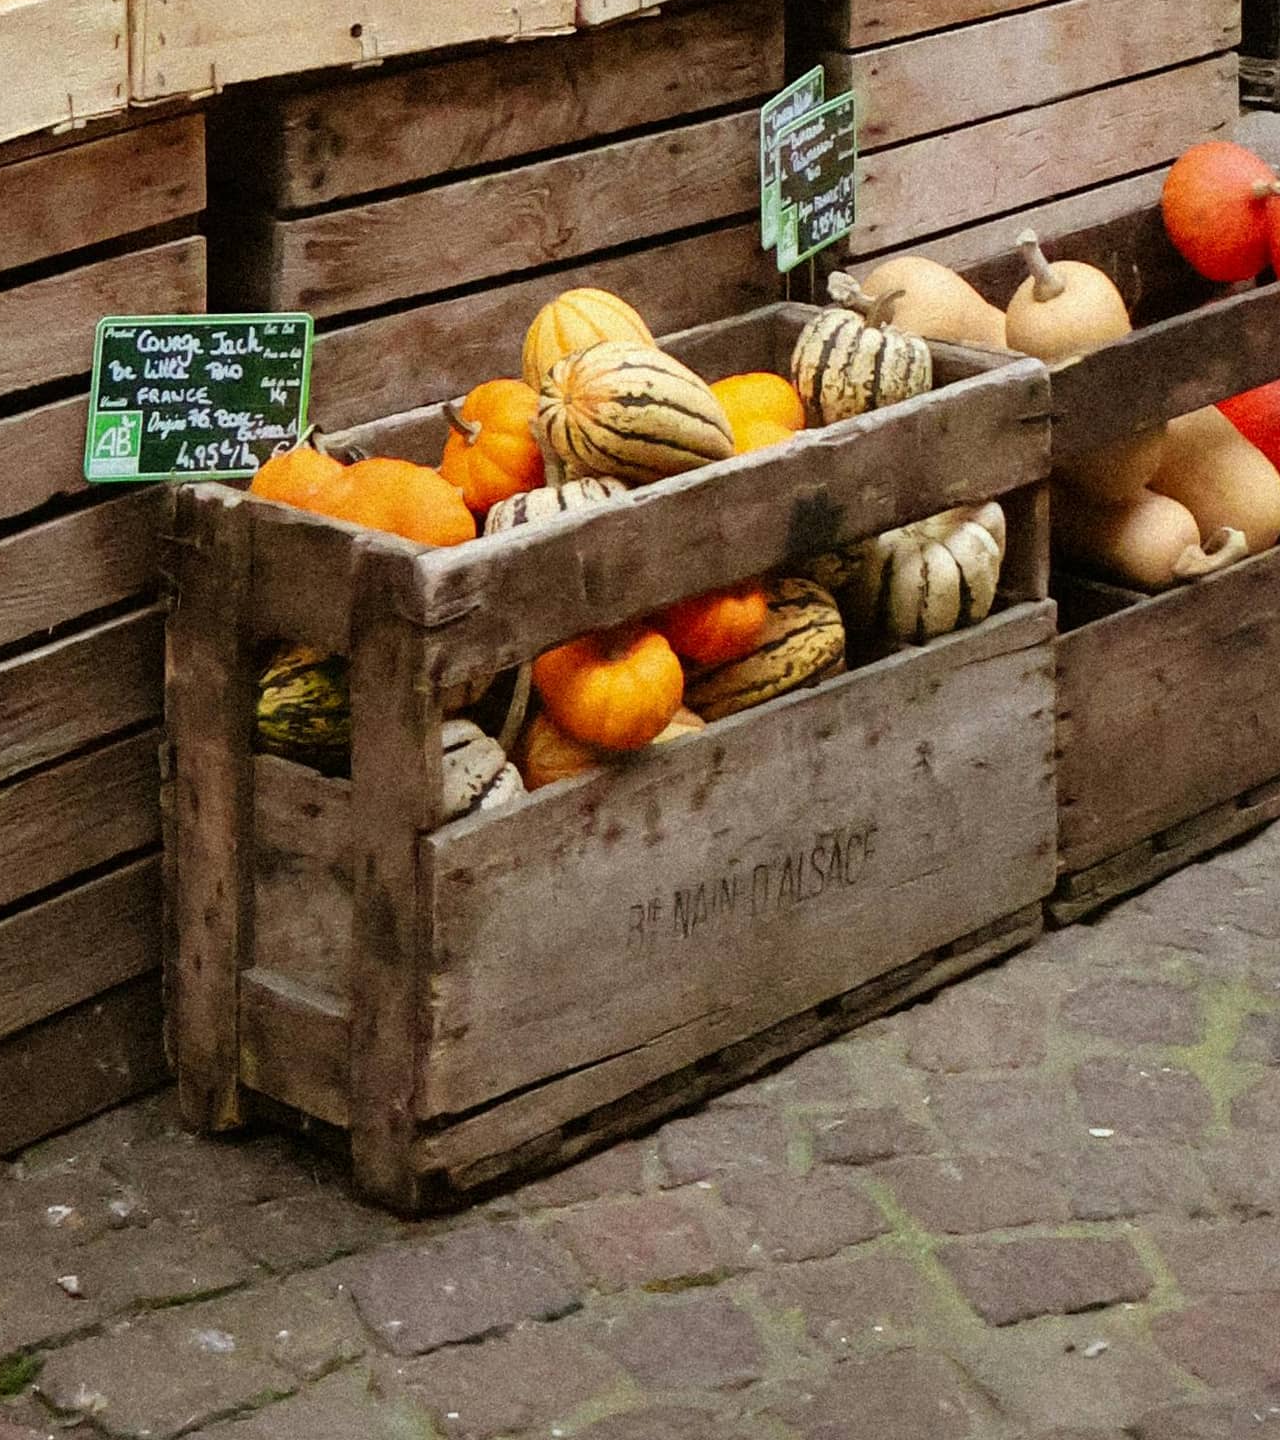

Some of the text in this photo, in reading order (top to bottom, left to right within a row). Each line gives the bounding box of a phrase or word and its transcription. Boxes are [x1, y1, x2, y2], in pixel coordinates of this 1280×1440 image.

[136, 329, 205, 368] Courge
[209, 326, 264, 356] Jack
[136, 386, 214, 405] FRANCE
